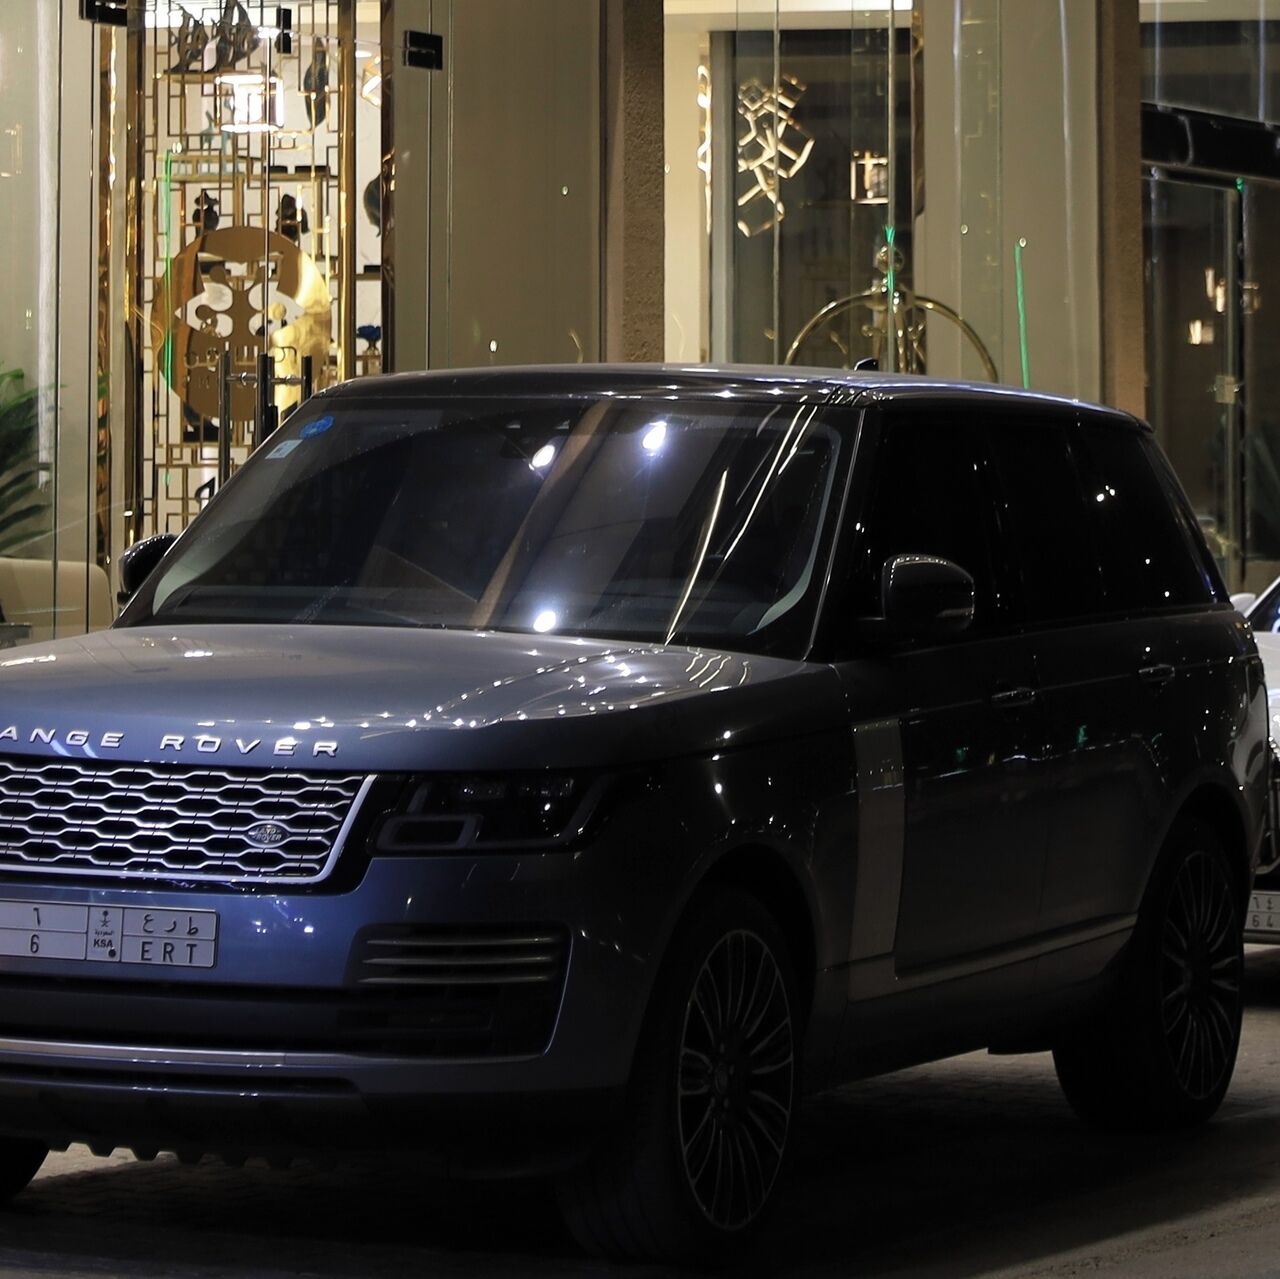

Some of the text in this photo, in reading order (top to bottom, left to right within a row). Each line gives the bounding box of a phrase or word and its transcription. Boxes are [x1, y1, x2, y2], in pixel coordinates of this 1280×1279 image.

[160, 734, 338, 757] ROVER
[30, 933, 40, 954] 6
[93, 938, 114, 948] KSA
